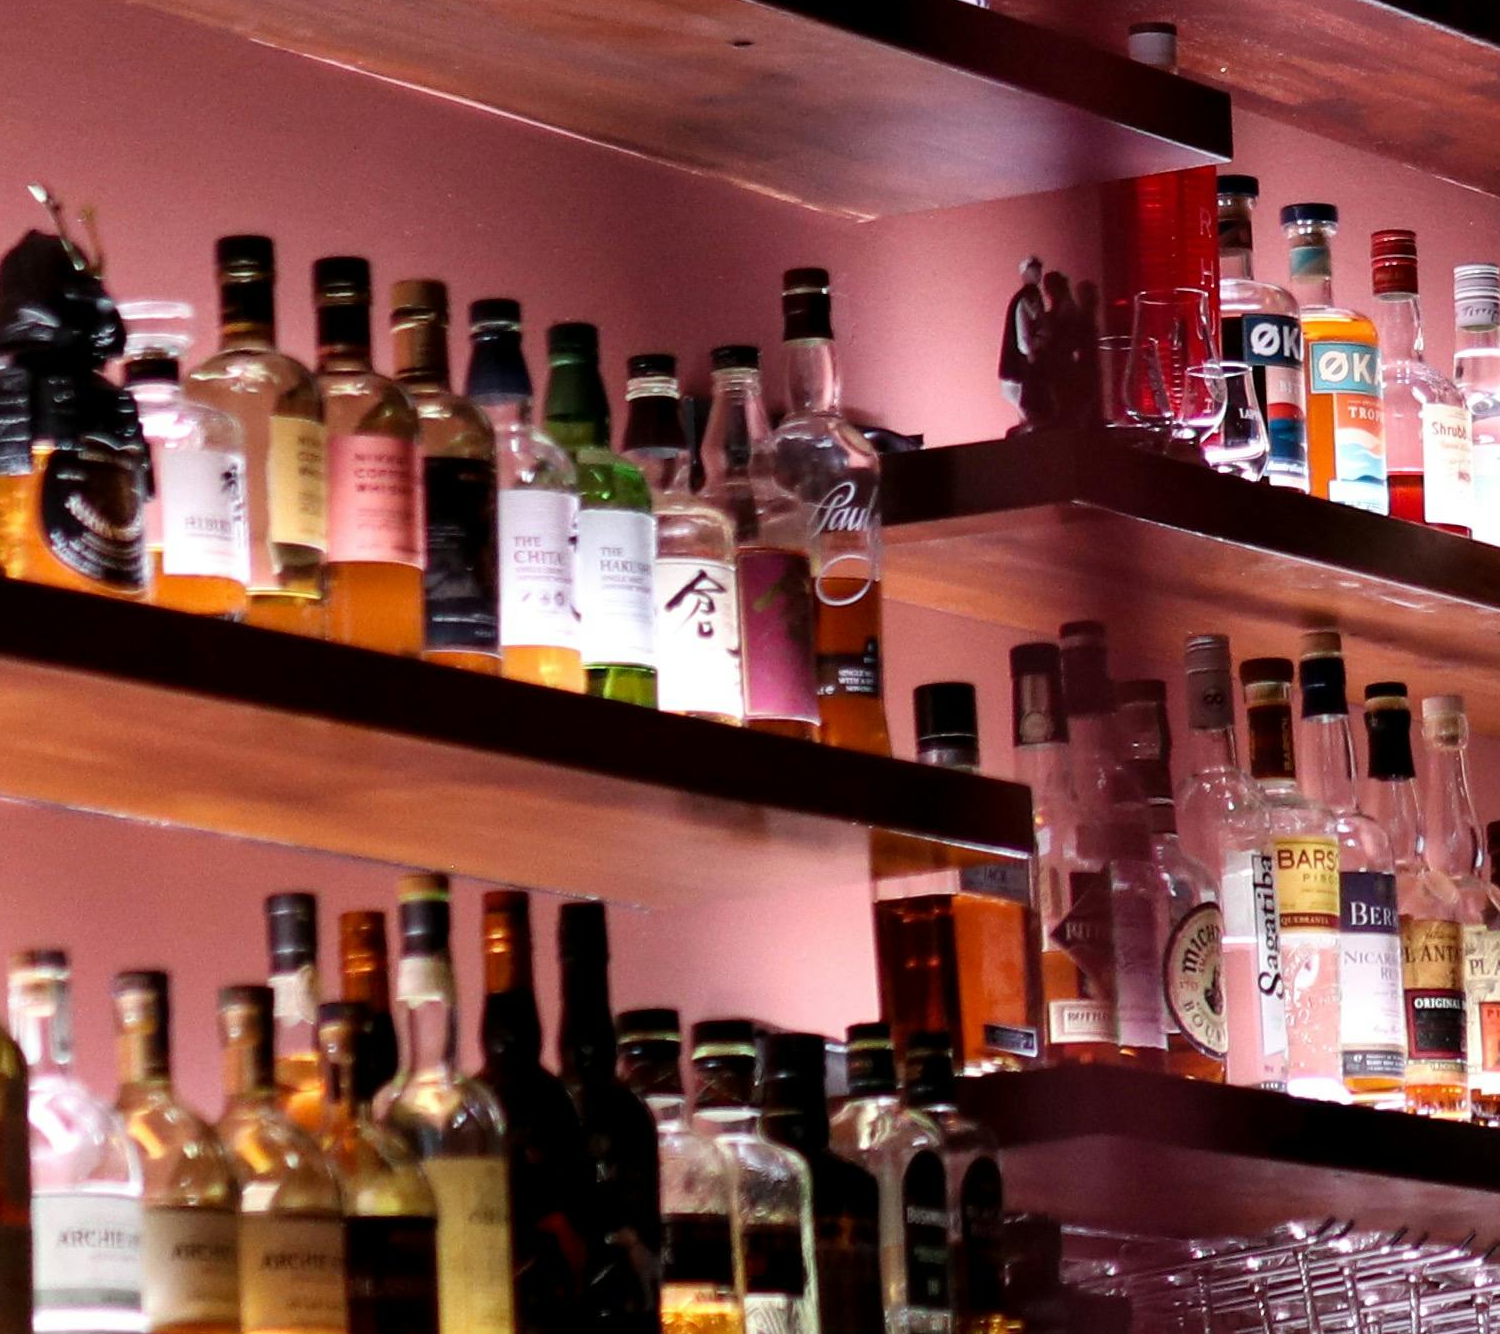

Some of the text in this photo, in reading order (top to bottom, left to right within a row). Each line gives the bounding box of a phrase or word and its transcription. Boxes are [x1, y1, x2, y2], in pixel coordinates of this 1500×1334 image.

[514, 536, 541, 547] THE
[513, 550, 567, 567] CHITA
[601, 547, 623, 557] THE
[1252, 854, 1285, 1000] Sagatiba
[1413, 997, 1460, 1010] ORIGINAL
